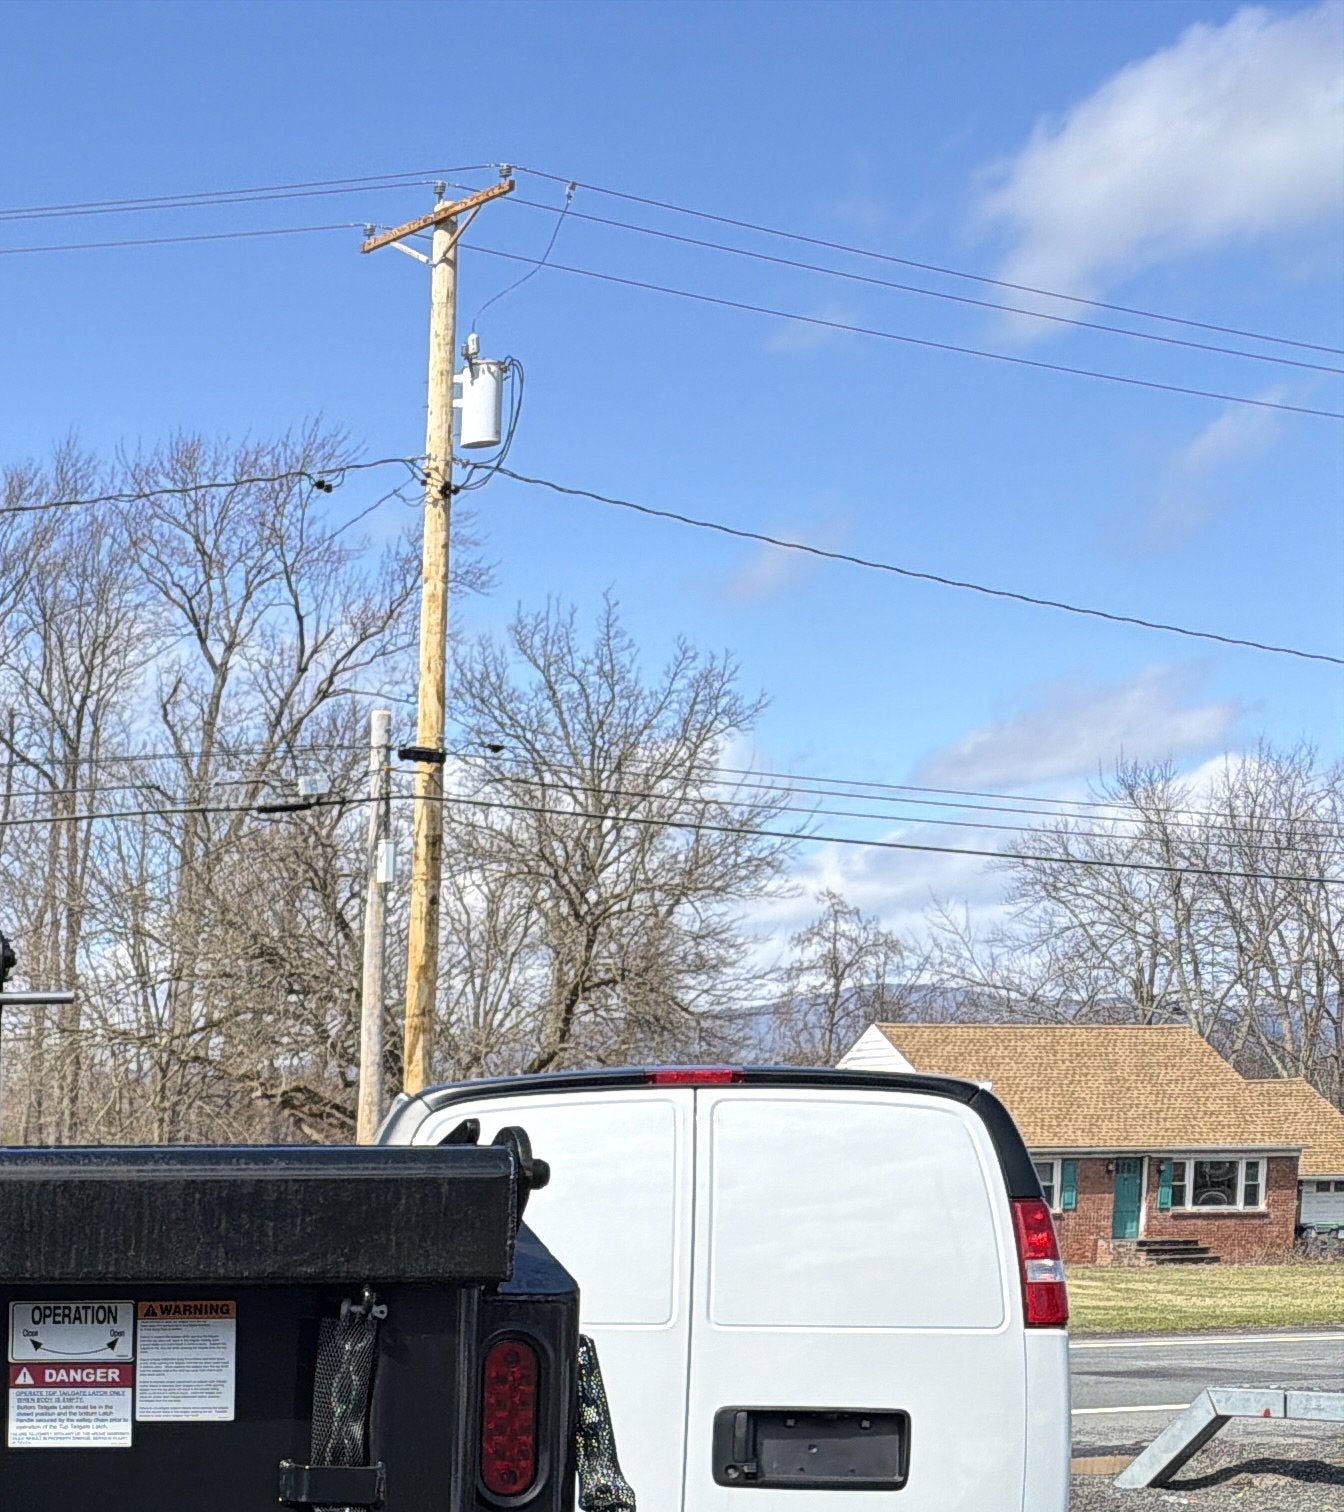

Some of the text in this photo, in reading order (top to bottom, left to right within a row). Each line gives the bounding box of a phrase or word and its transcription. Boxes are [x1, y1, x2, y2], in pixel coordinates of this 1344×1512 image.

[31, 1305, 118, 1325] OPERATION
[158, 1303, 230, 1316] WARNING
[22, 1329, 38, 1337] Close
[110, 1329, 125, 1337] Open
[44, 1368, 120, 1383] DANGER
